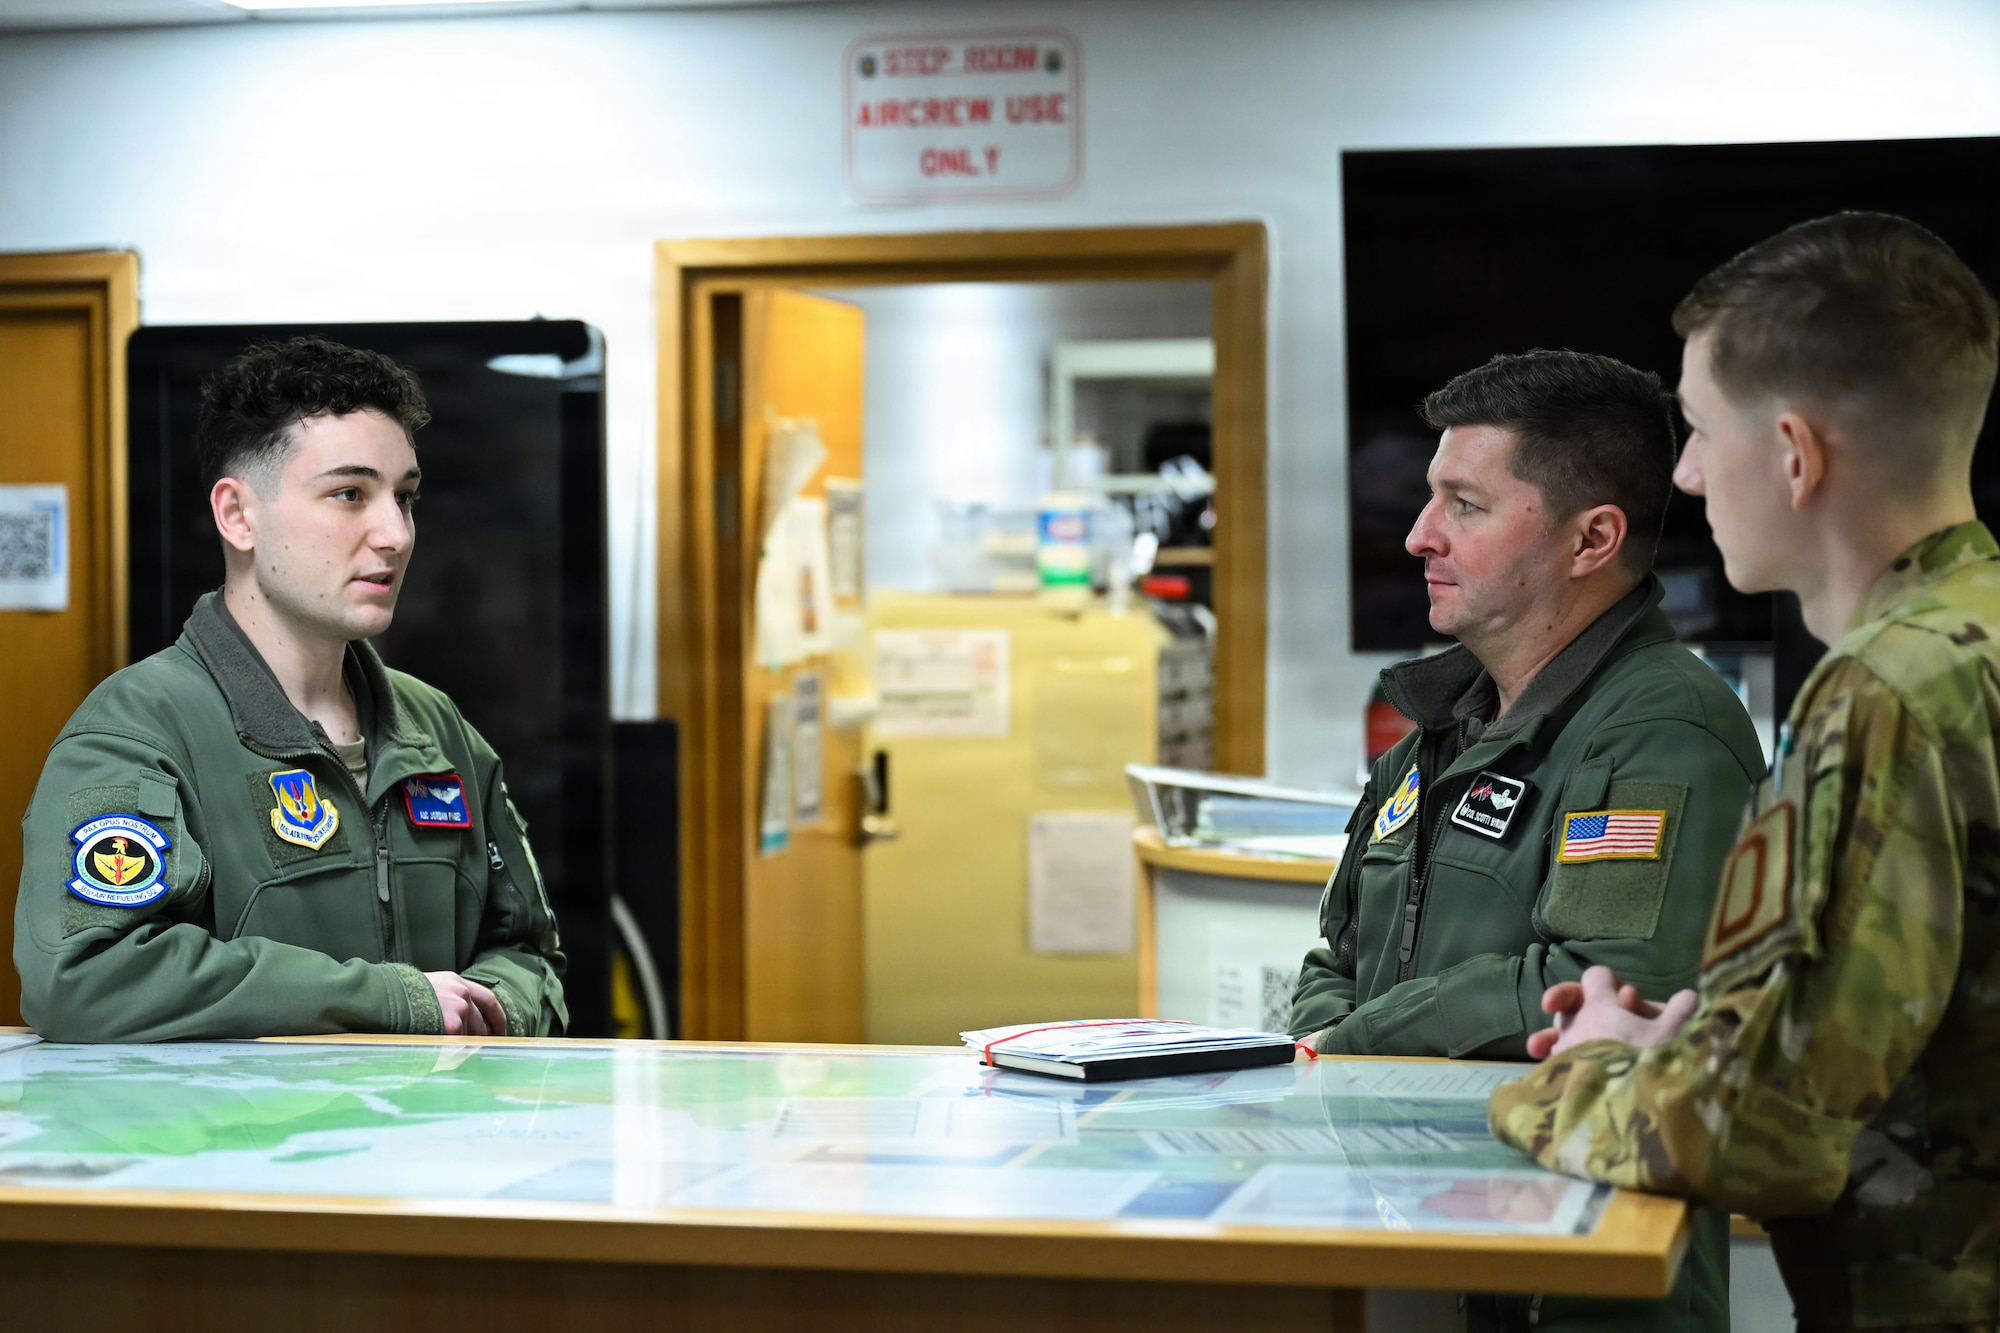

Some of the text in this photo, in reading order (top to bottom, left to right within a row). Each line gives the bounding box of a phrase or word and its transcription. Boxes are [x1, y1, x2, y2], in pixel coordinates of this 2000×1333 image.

[884, 45, 1039, 78] STEP ROOM
[857, 94, 1067, 128] AIRCREW USE
[919, 147, 1001, 177] ONLY
[82, 818, 158, 839] PAX OPUS NOSTRUM
[106, 892, 147, 903] REFUELING
